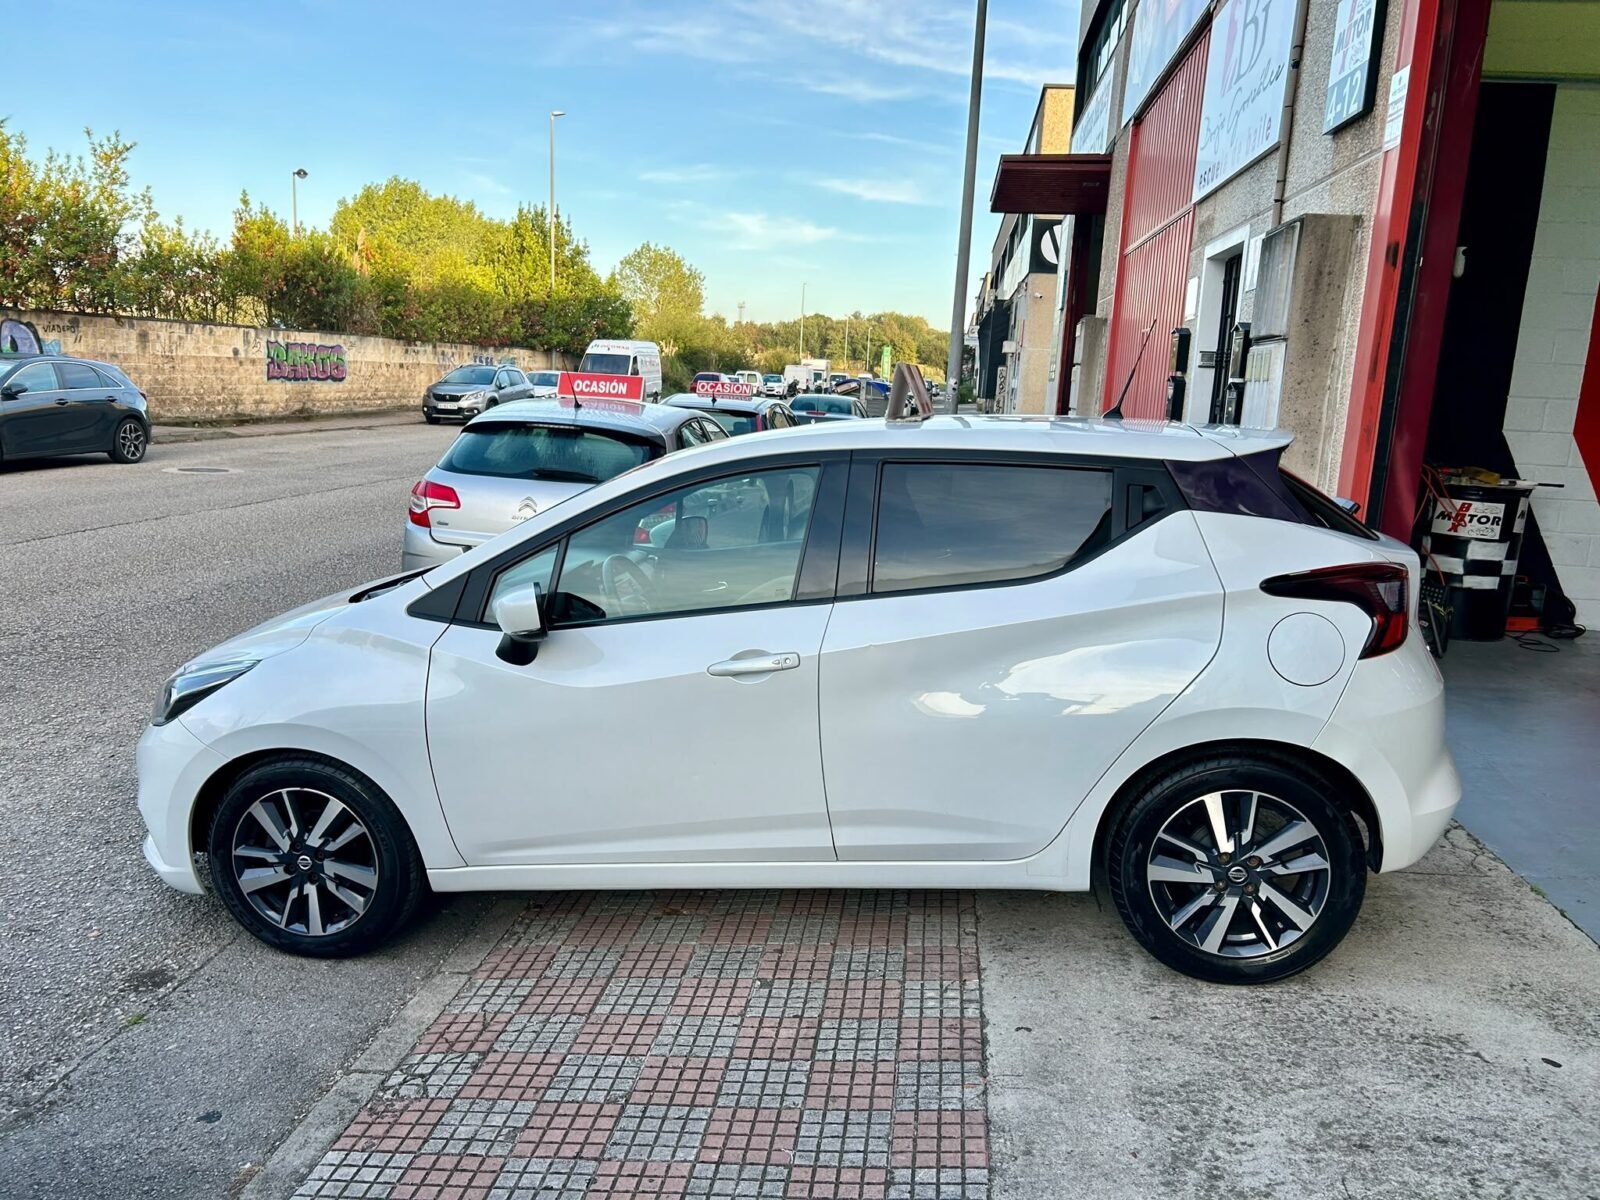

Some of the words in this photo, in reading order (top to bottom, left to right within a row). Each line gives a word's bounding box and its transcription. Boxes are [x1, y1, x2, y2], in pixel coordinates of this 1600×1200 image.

[1326, 69, 1362, 126] 4-12
[573, 379, 628, 394] OCASIÓN
[699, 382, 751, 394] OCASION
[1435, 510, 1502, 527] MOTOR
